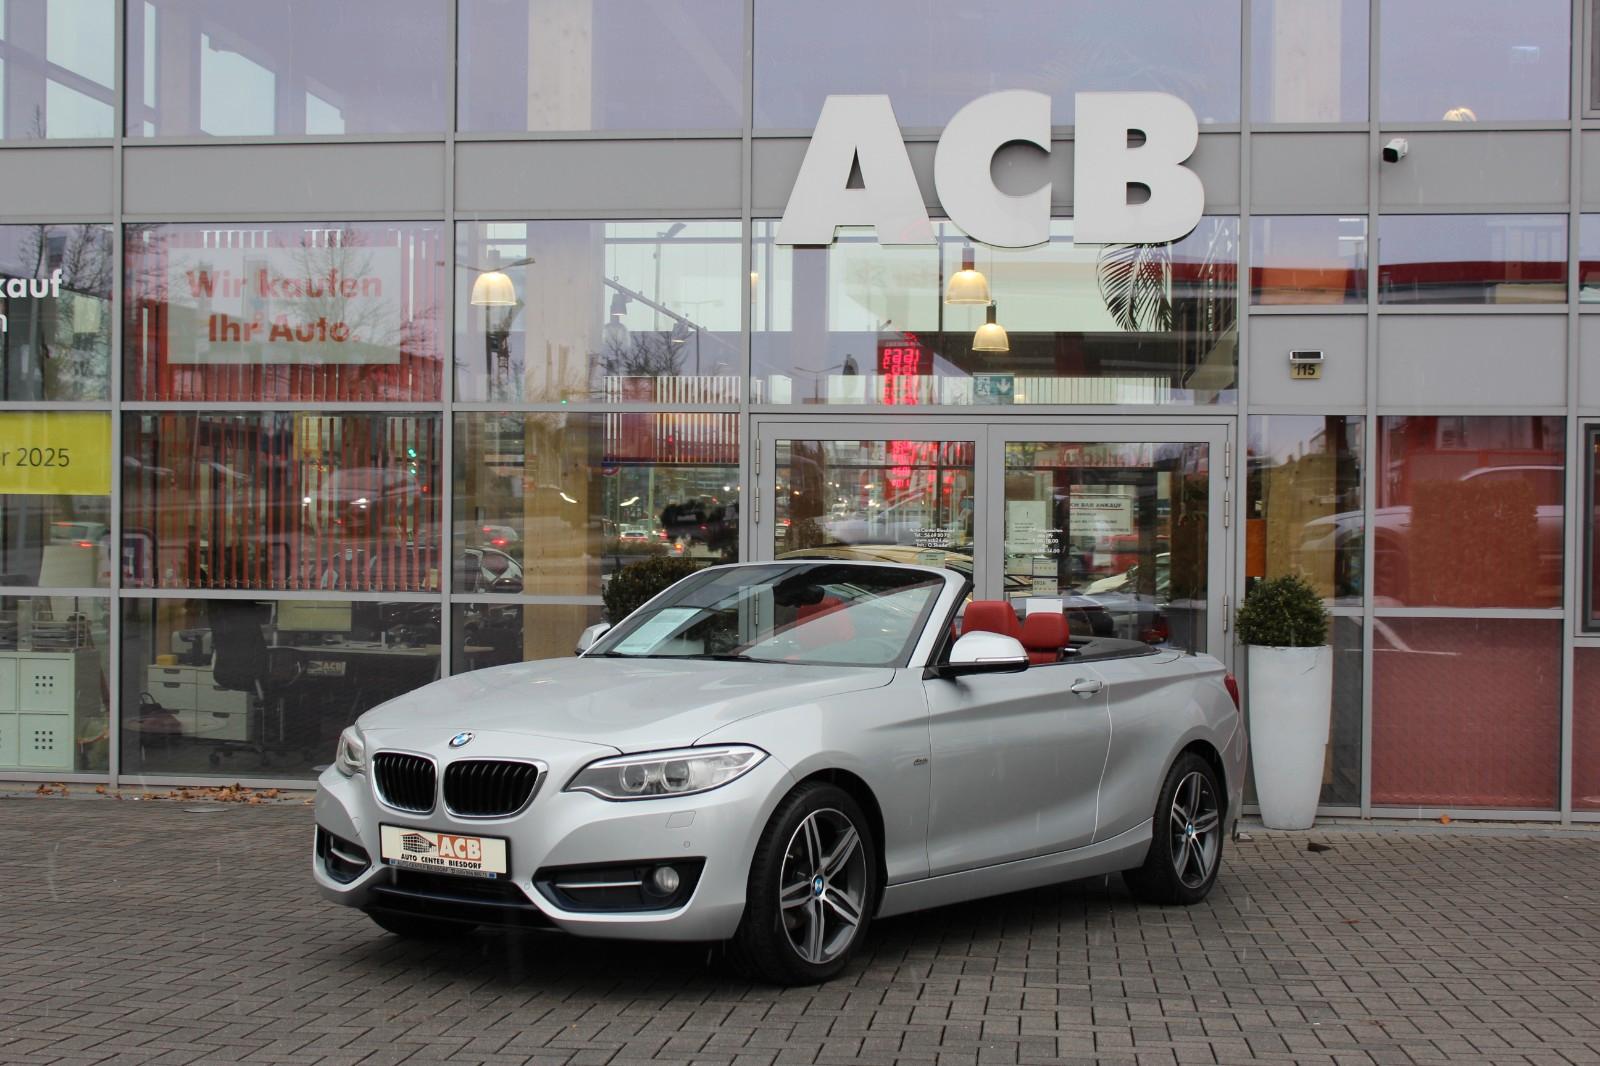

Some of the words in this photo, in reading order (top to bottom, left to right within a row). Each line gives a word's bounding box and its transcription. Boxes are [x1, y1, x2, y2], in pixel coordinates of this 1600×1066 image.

[775, 89, 1205, 248] ACB
[187, 270, 248, 298] Wir
[257, 267, 382, 298] kaufen
[209, 313, 261, 342] Ihr
[1296, 363, 1316, 376] 115
[16, 447, 70, 468] 2025
[439, 836, 481, 860] ACB
[401, 853, 418, 862] AUTO
[421, 856, 445, 865] CENTER
[448, 860, 482, 869] BIESDORF
